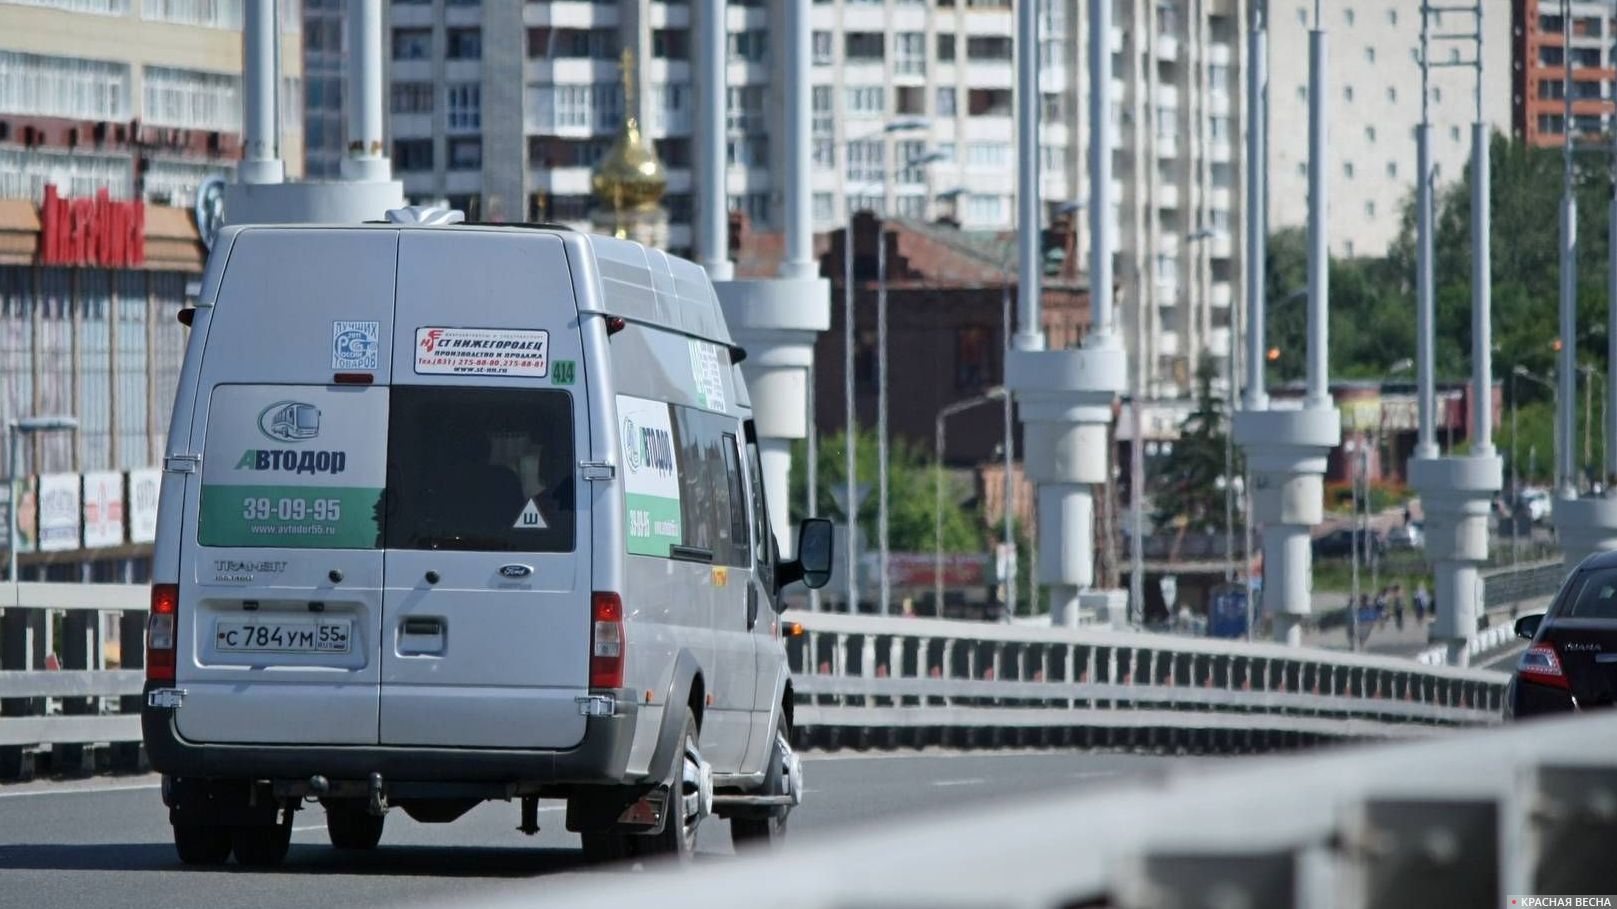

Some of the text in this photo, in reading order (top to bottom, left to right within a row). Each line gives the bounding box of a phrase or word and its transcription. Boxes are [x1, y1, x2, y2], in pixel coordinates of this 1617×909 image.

[438, 339, 543, 350] СТ НИЖЕГОРОДЕЦ
[553, 361, 574, 383] 414
[243, 498, 341, 520] 39-09-95
[523, 512, 538, 525] Ш
[251, 524, 336, 535] www.avtodor55.ru
[319, 626, 340, 641] 55
